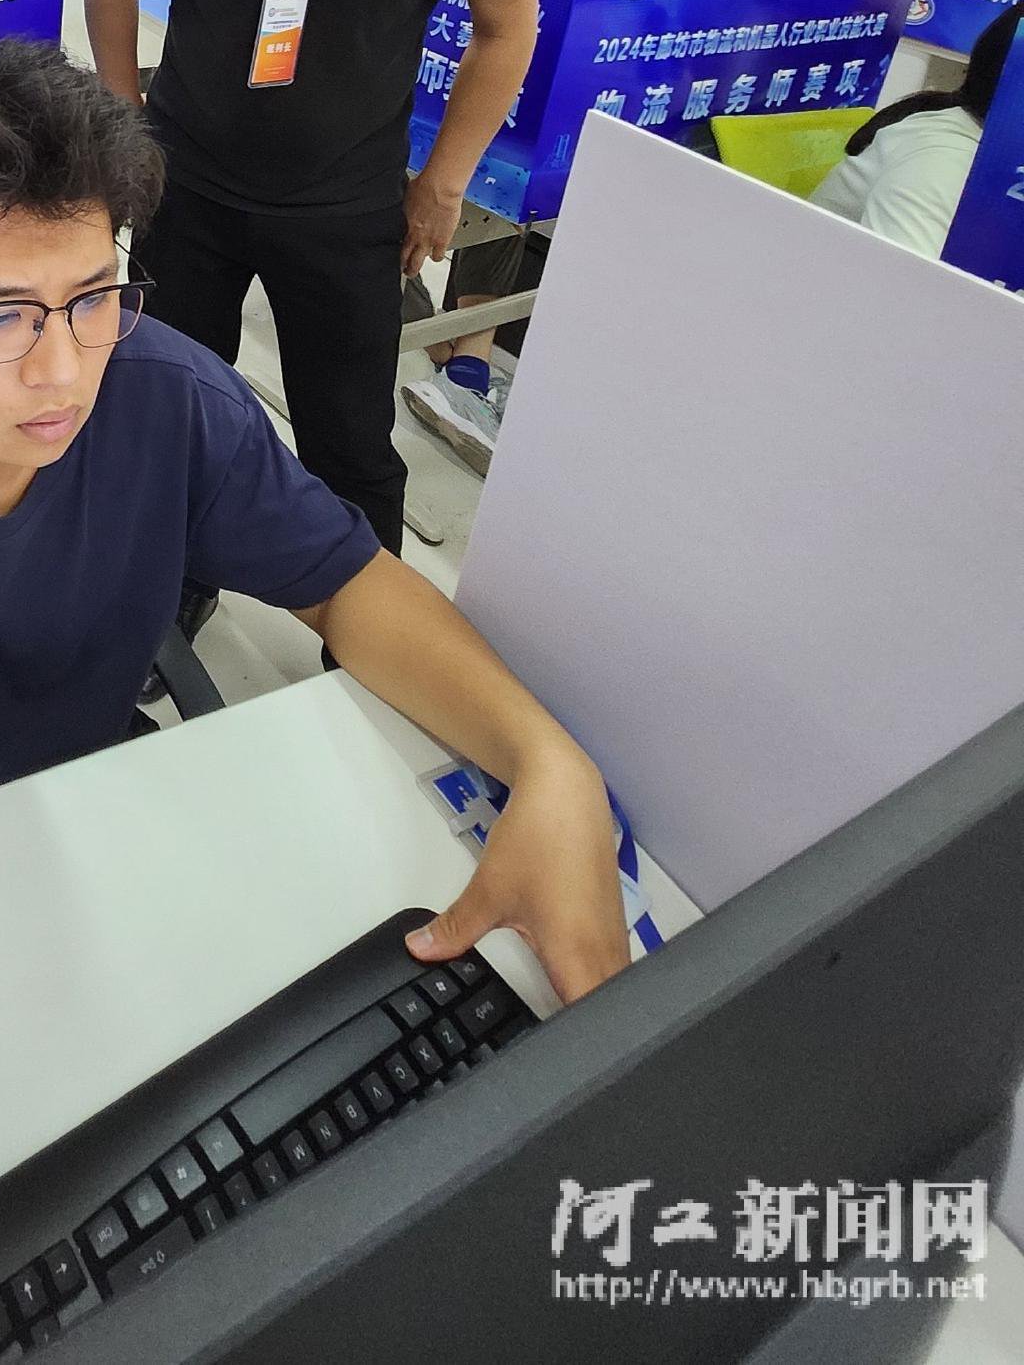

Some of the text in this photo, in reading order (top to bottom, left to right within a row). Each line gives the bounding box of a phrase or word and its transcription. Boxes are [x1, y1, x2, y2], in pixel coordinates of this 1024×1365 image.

[593, 13, 888, 63] 2024年廊坊市物流和机器人行业职业技能大赛
